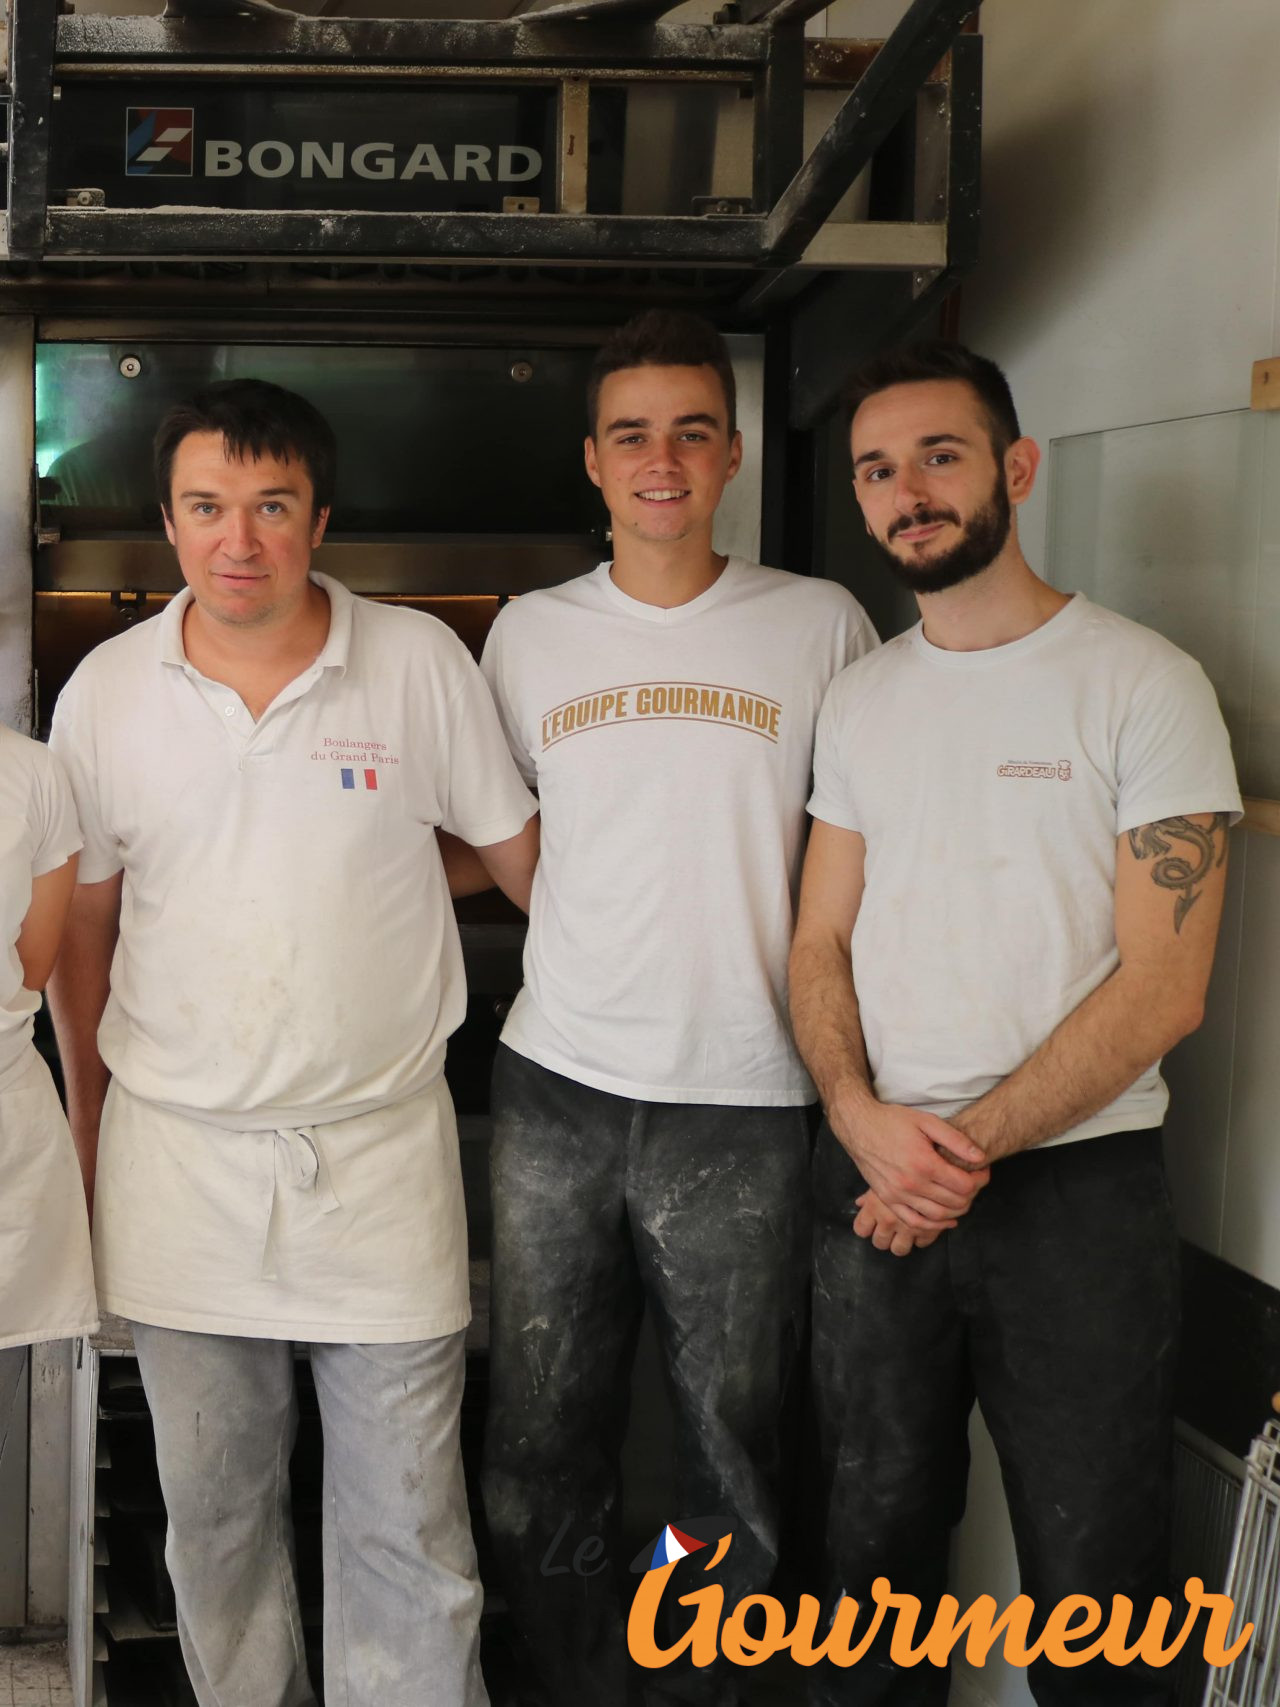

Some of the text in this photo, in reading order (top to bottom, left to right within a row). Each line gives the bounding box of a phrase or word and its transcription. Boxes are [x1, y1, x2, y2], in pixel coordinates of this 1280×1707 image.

[205, 140, 542, 182] BONGARD
[542, 687, 781, 746] L'EQUIPE GOURMANDE
[310, 751, 400, 765] du Grand Paris
[323, 737, 387, 751] Boulangers
